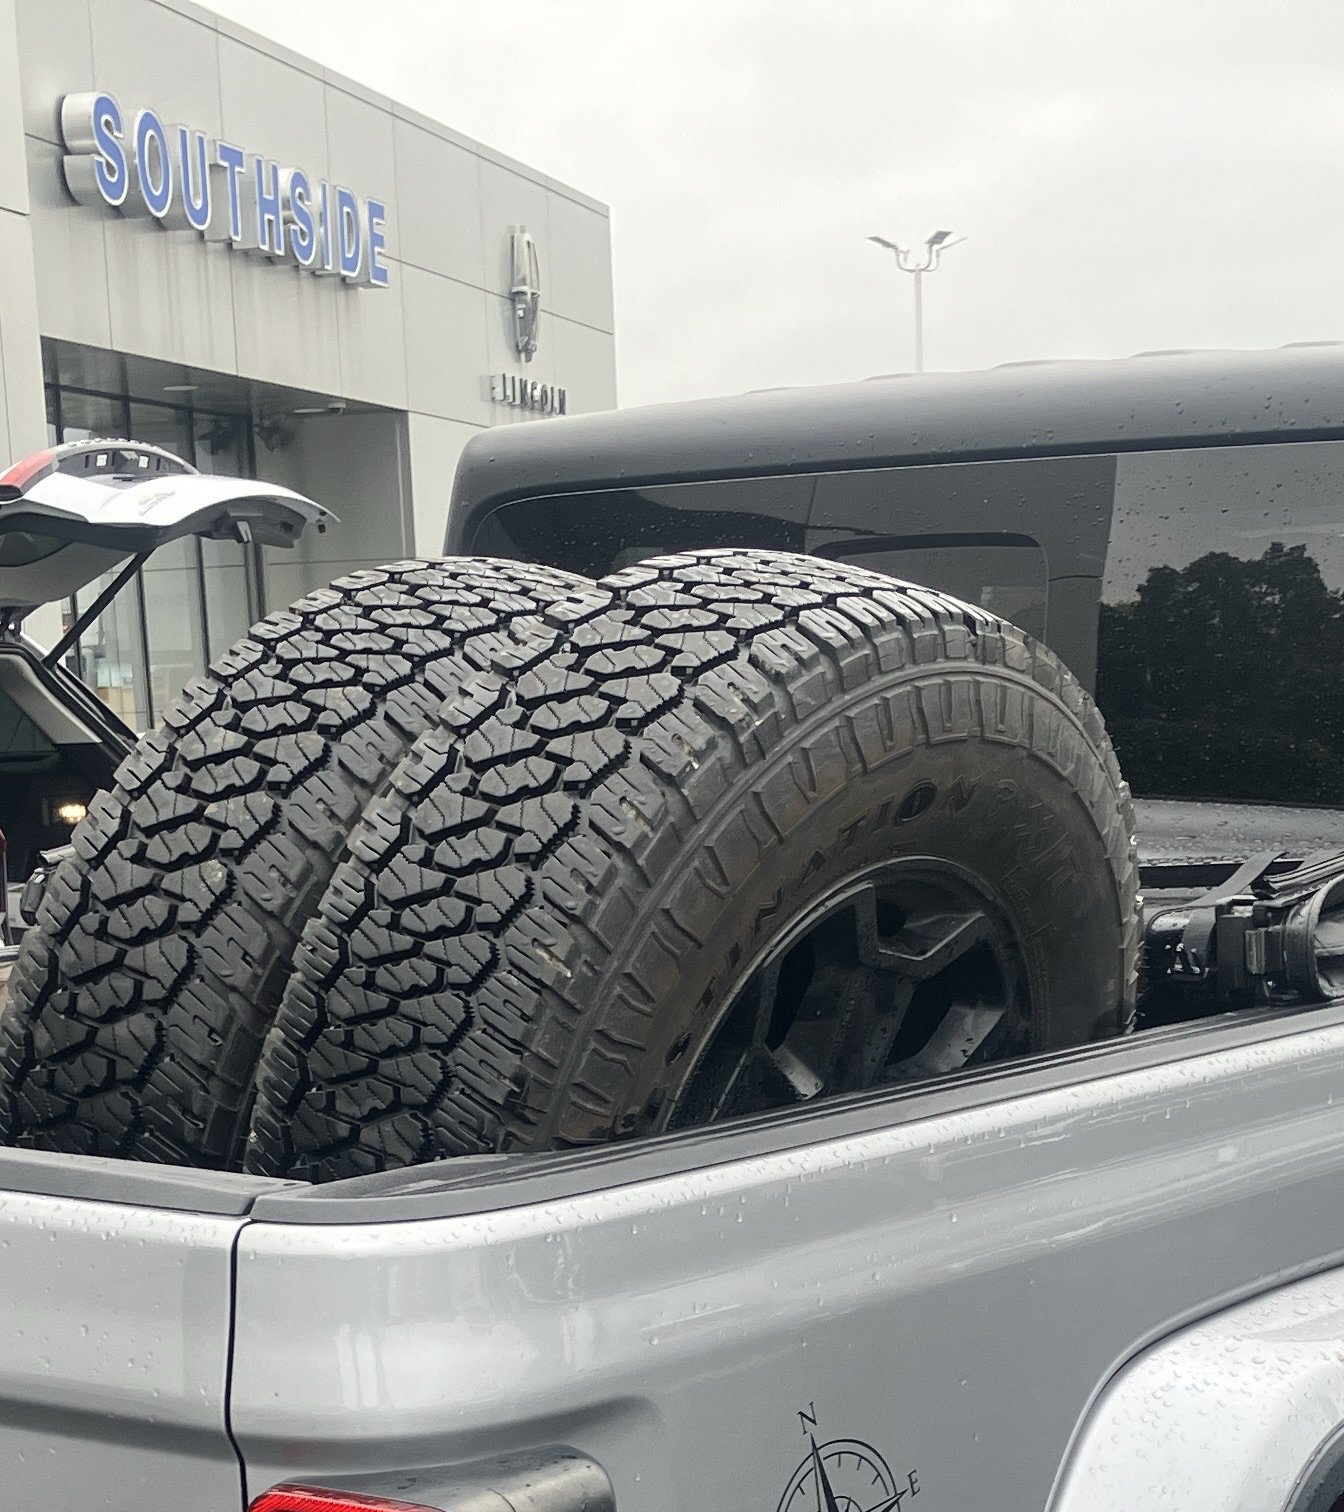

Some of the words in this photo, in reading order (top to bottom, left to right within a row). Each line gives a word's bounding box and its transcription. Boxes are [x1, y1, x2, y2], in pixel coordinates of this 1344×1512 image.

[88, 91, 390, 288] SOUTHSIDE
[796, 1401, 818, 1436] N
[906, 1469, 921, 1498] E
